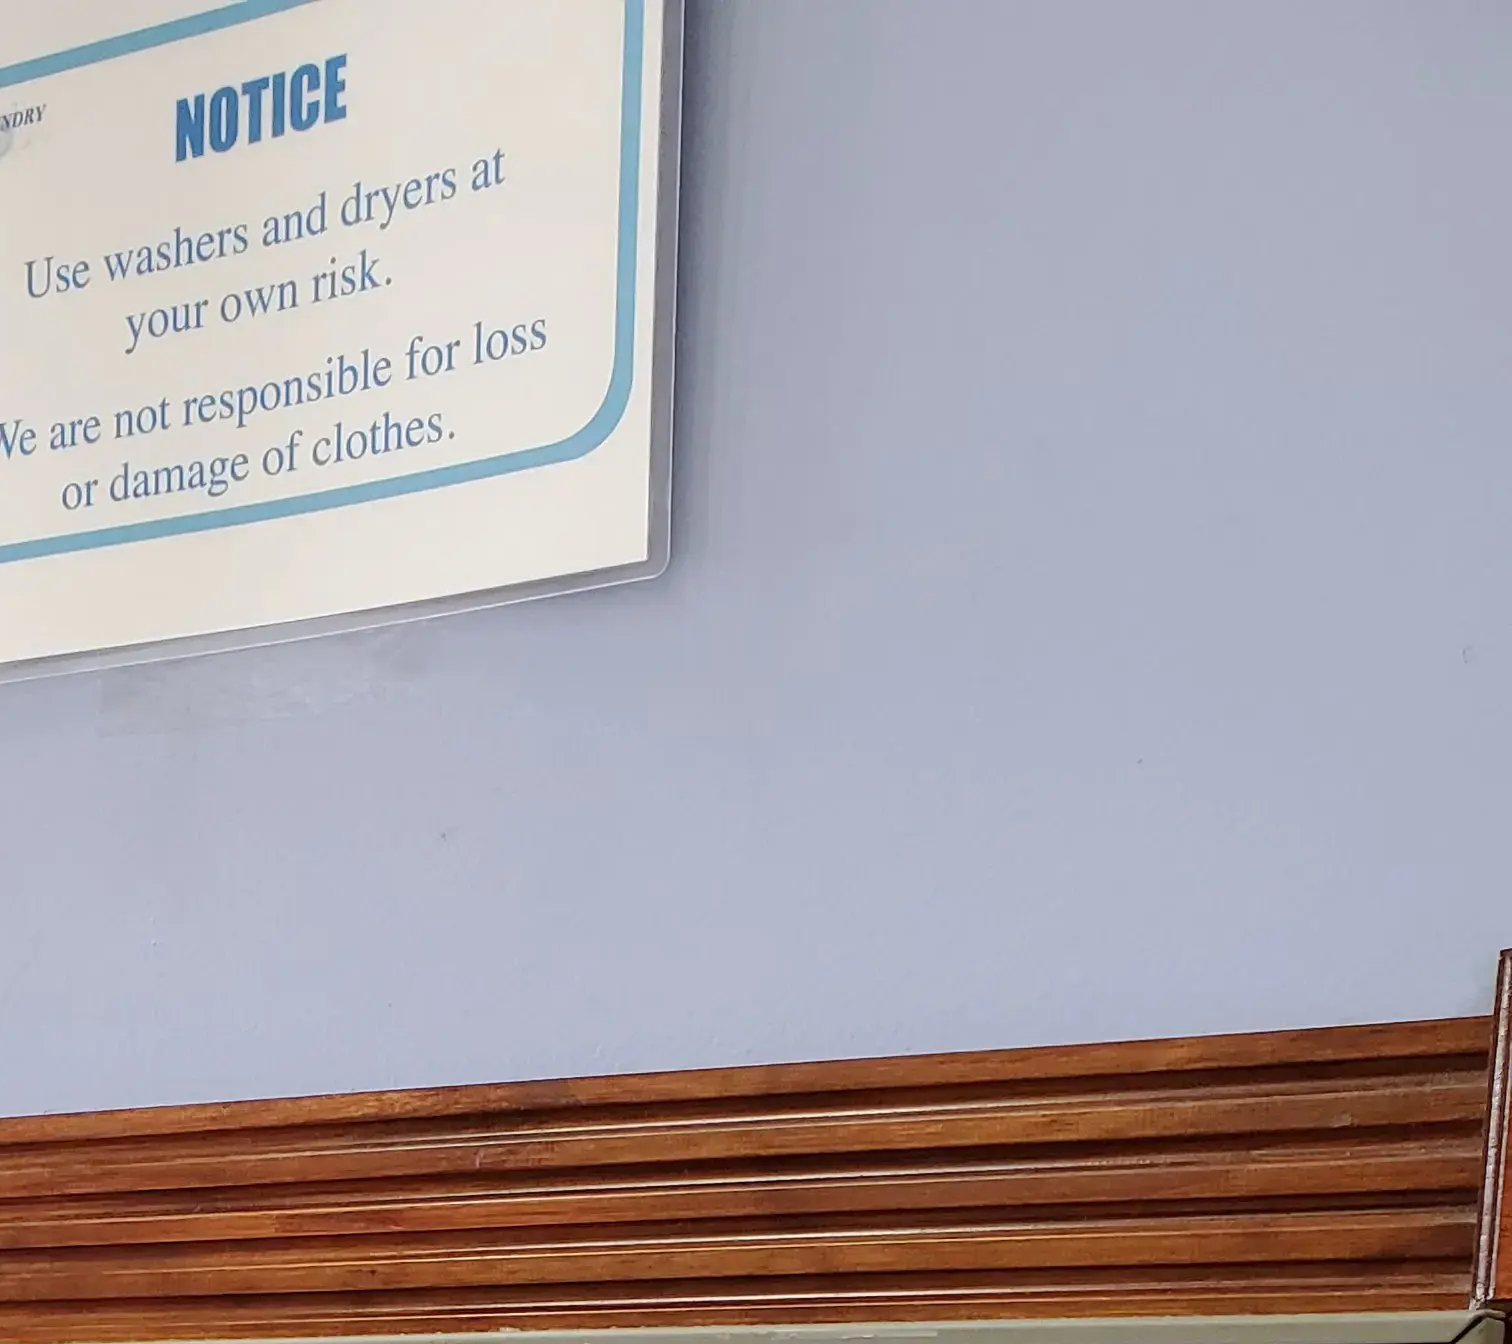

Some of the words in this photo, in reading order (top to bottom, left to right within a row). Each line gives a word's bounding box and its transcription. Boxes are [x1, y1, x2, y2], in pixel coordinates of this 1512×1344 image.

[174, 53, 349, 163] NOTICE
[24, 257, 91, 298] Use
[103, 221, 249, 284] washers
[261, 192, 328, 247] and
[339, 172, 458, 232] dryers
[470, 147, 507, 190] at
[124, 298, 209, 354] your
[219, 279, 299, 324] own
[311, 248, 393, 304] risk.
[49, 415, 101, 450] are
[113, 396, 171, 440] not
[182, 350, 393, 430] responsible
[403, 335, 462, 381] for
[472, 315, 548, 365] loss
[60, 476, 97, 511] or
[109, 450, 251, 503] damage
[261, 432, 303, 477] of
[311, 405, 456, 467] clothes.
